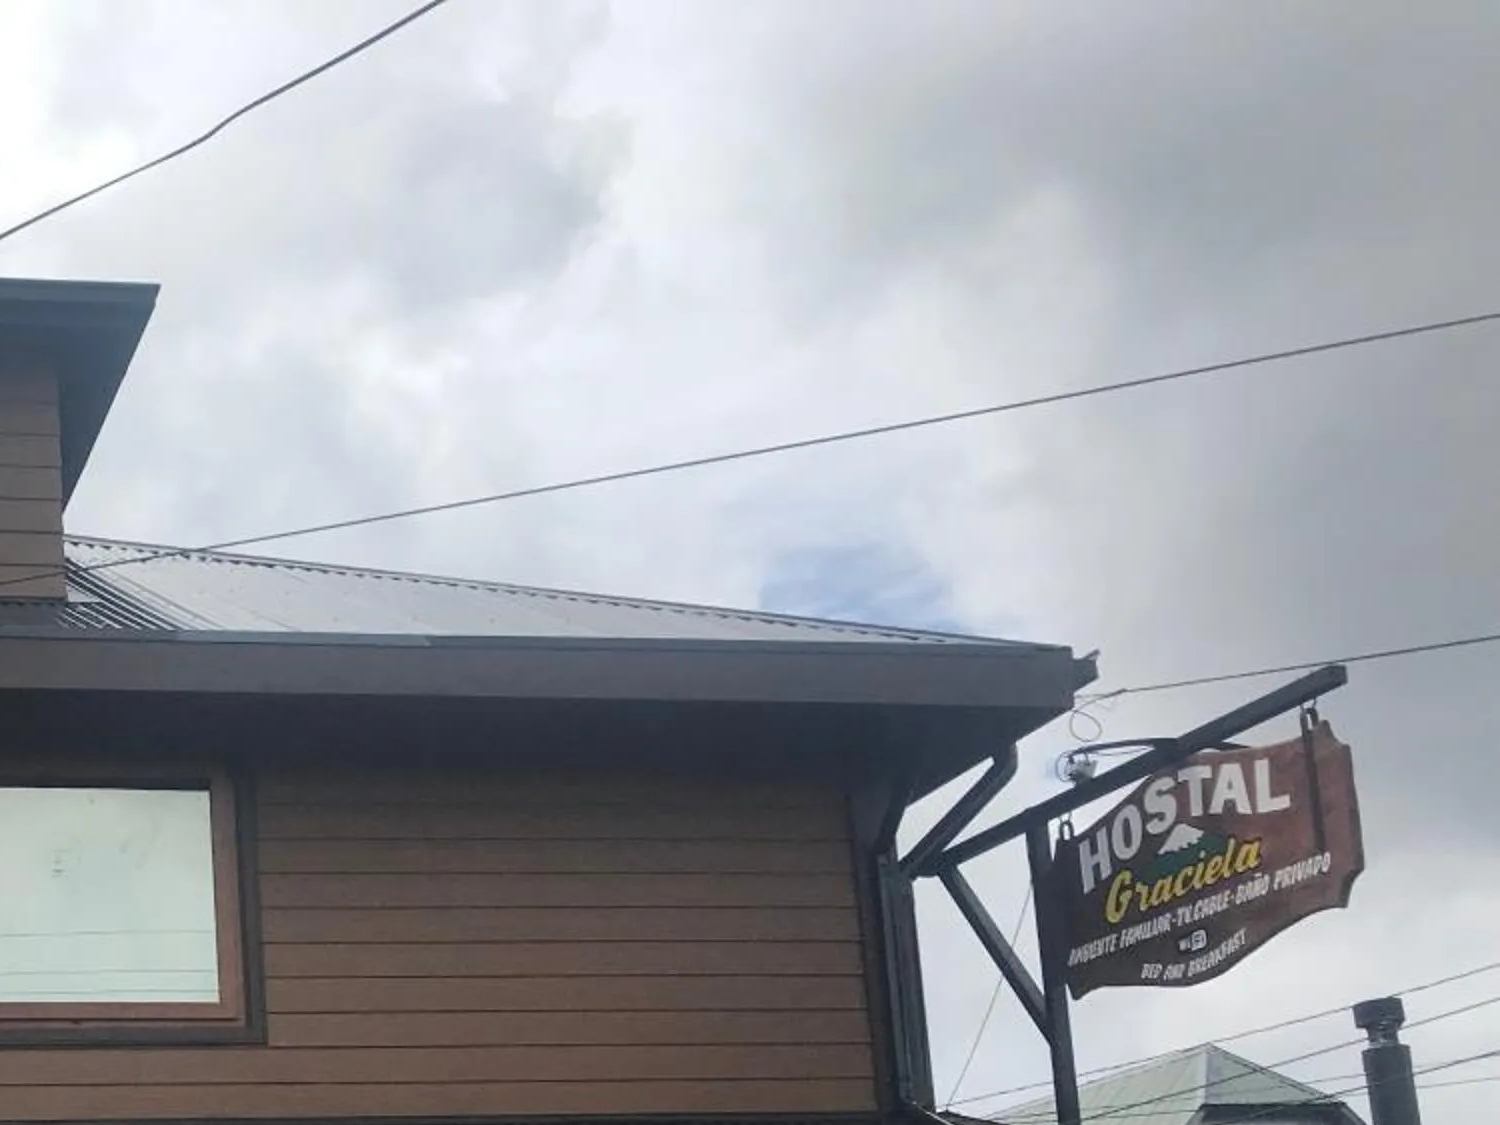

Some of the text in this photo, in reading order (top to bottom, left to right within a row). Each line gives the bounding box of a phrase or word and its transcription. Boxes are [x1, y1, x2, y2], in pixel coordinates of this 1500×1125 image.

[1078, 757, 1291, 895] HOSTAL
[1104, 836, 1262, 924] Graciela
[1272, 851, 1331, 891] PRIVADO
[1187, 927, 1247, 977] BREAKFAST
